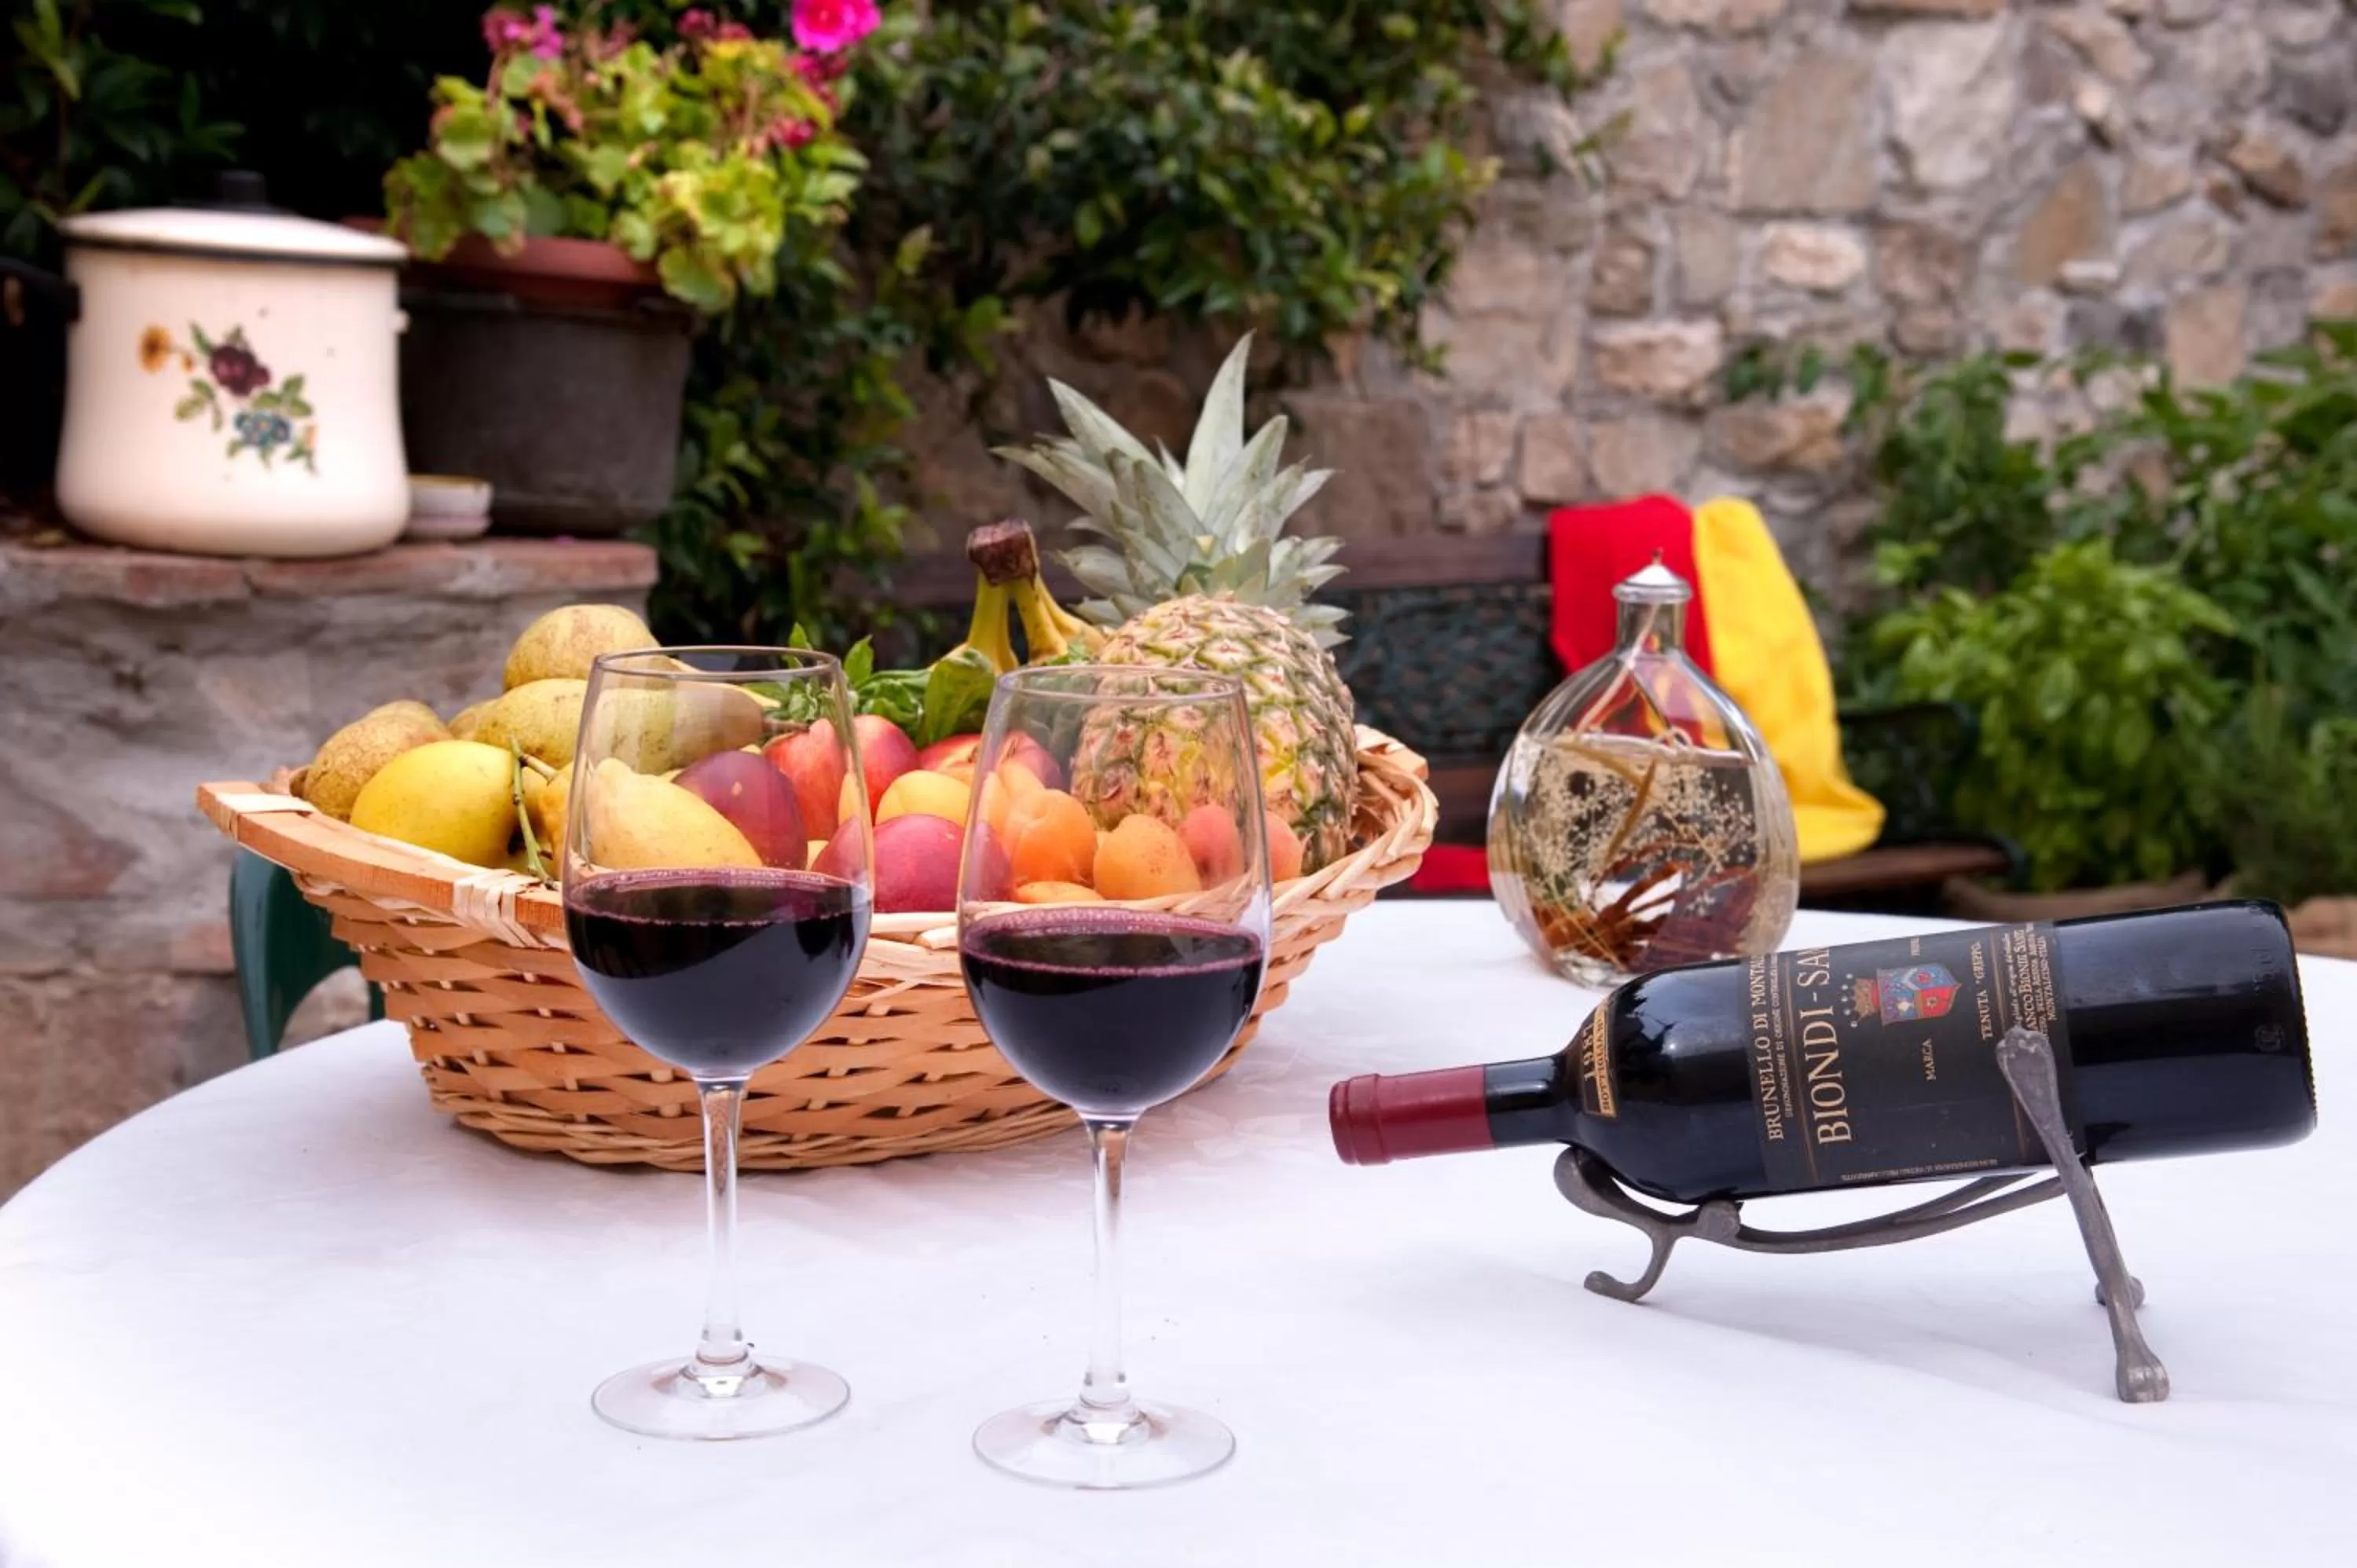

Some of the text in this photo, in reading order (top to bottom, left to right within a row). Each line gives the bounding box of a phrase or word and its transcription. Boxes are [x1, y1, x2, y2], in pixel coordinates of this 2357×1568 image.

[1752, 1012, 1769, 1030] DI
[1976, 988, 1993, 1041] TENUTA
[1919, 1038, 1937, 1082] MARCA
[1754, 1035, 1785, 1141] BRUNELLO
